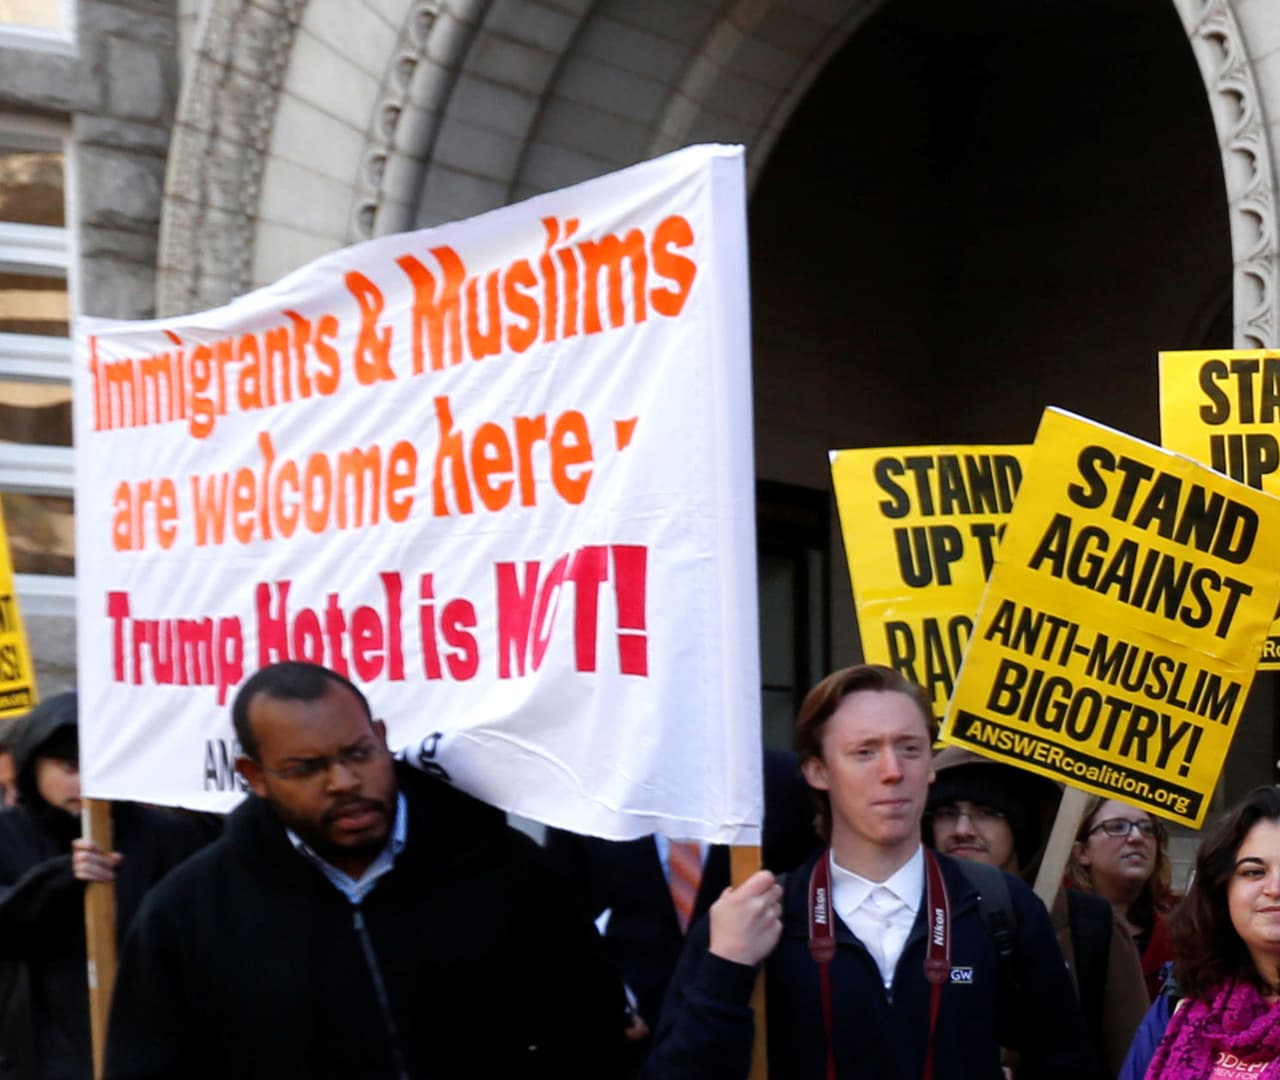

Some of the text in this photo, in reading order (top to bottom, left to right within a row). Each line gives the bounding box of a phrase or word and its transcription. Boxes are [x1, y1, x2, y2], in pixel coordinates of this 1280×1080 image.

[88, 215, 697, 441] Immigrants & Muslims
[113, 478, 177, 551] are
[195, 432, 417, 546] welcome
[433, 395, 593, 518] here
[873, 454, 1023, 520] STAND
[1067, 444, 1260, 566] STAND
[893, 524, 964, 588] UP
[1027, 512, 1254, 640] AGAINST
[107, 543, 649, 706] Trump Hotel is NOT!
[983, 598, 1243, 727] ANTI-MUSLIM
[965, 719, 1191, 815] ANSWERcoalition.org
[985, 657, 1205, 779] BIGOTRY!
[814, 887, 827, 925] Nikon
[932, 908, 946, 947] Nikon
[950, 969, 974, 982] GW
